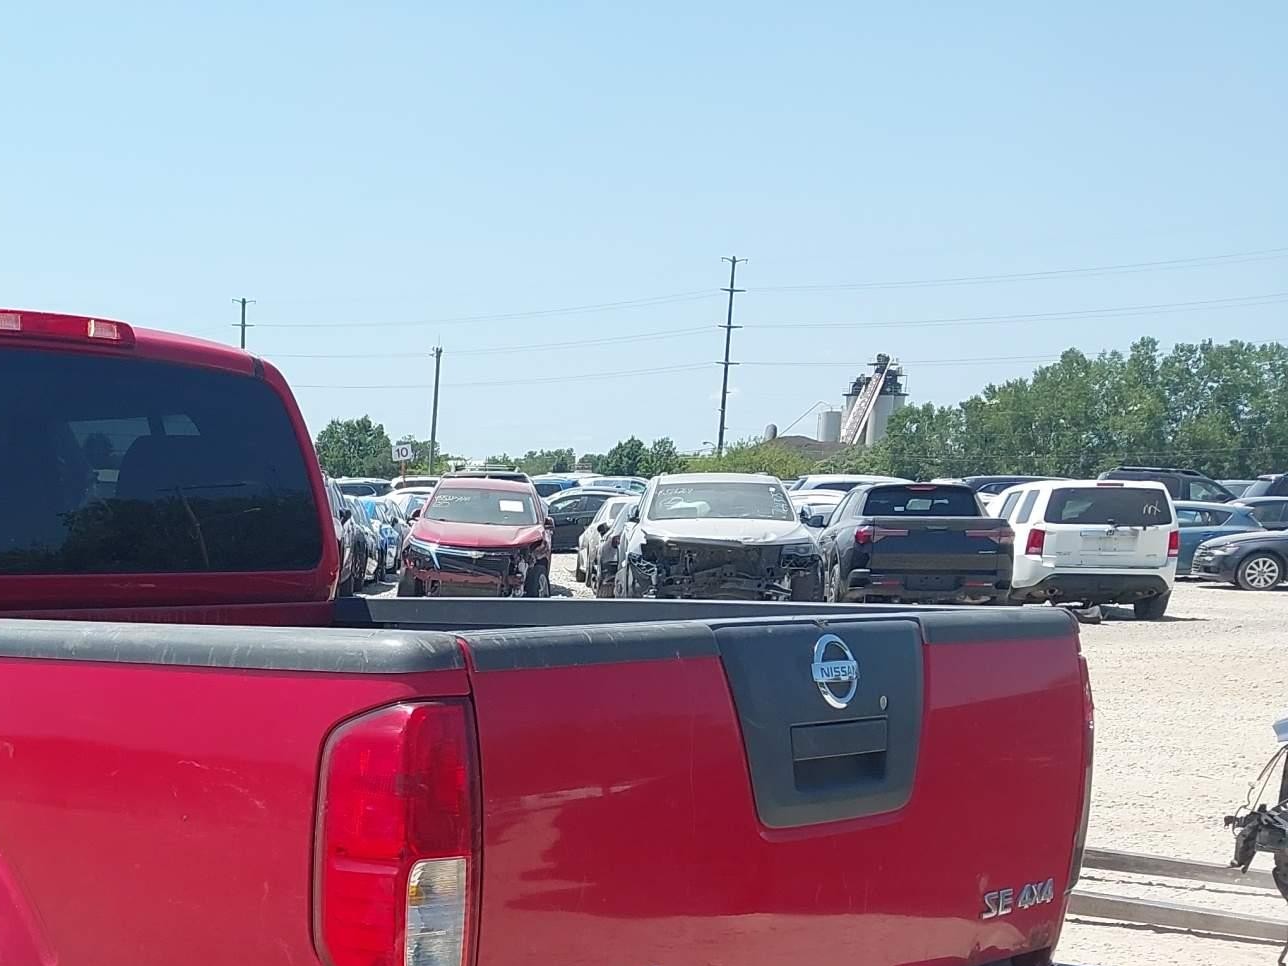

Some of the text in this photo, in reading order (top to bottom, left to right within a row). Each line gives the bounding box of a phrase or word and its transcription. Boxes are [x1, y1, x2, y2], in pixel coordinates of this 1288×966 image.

[395, 447, 409, 458] 10
[820, 665, 857, 678] NISSA
[982, 877, 1054, 920] SE 4X4
